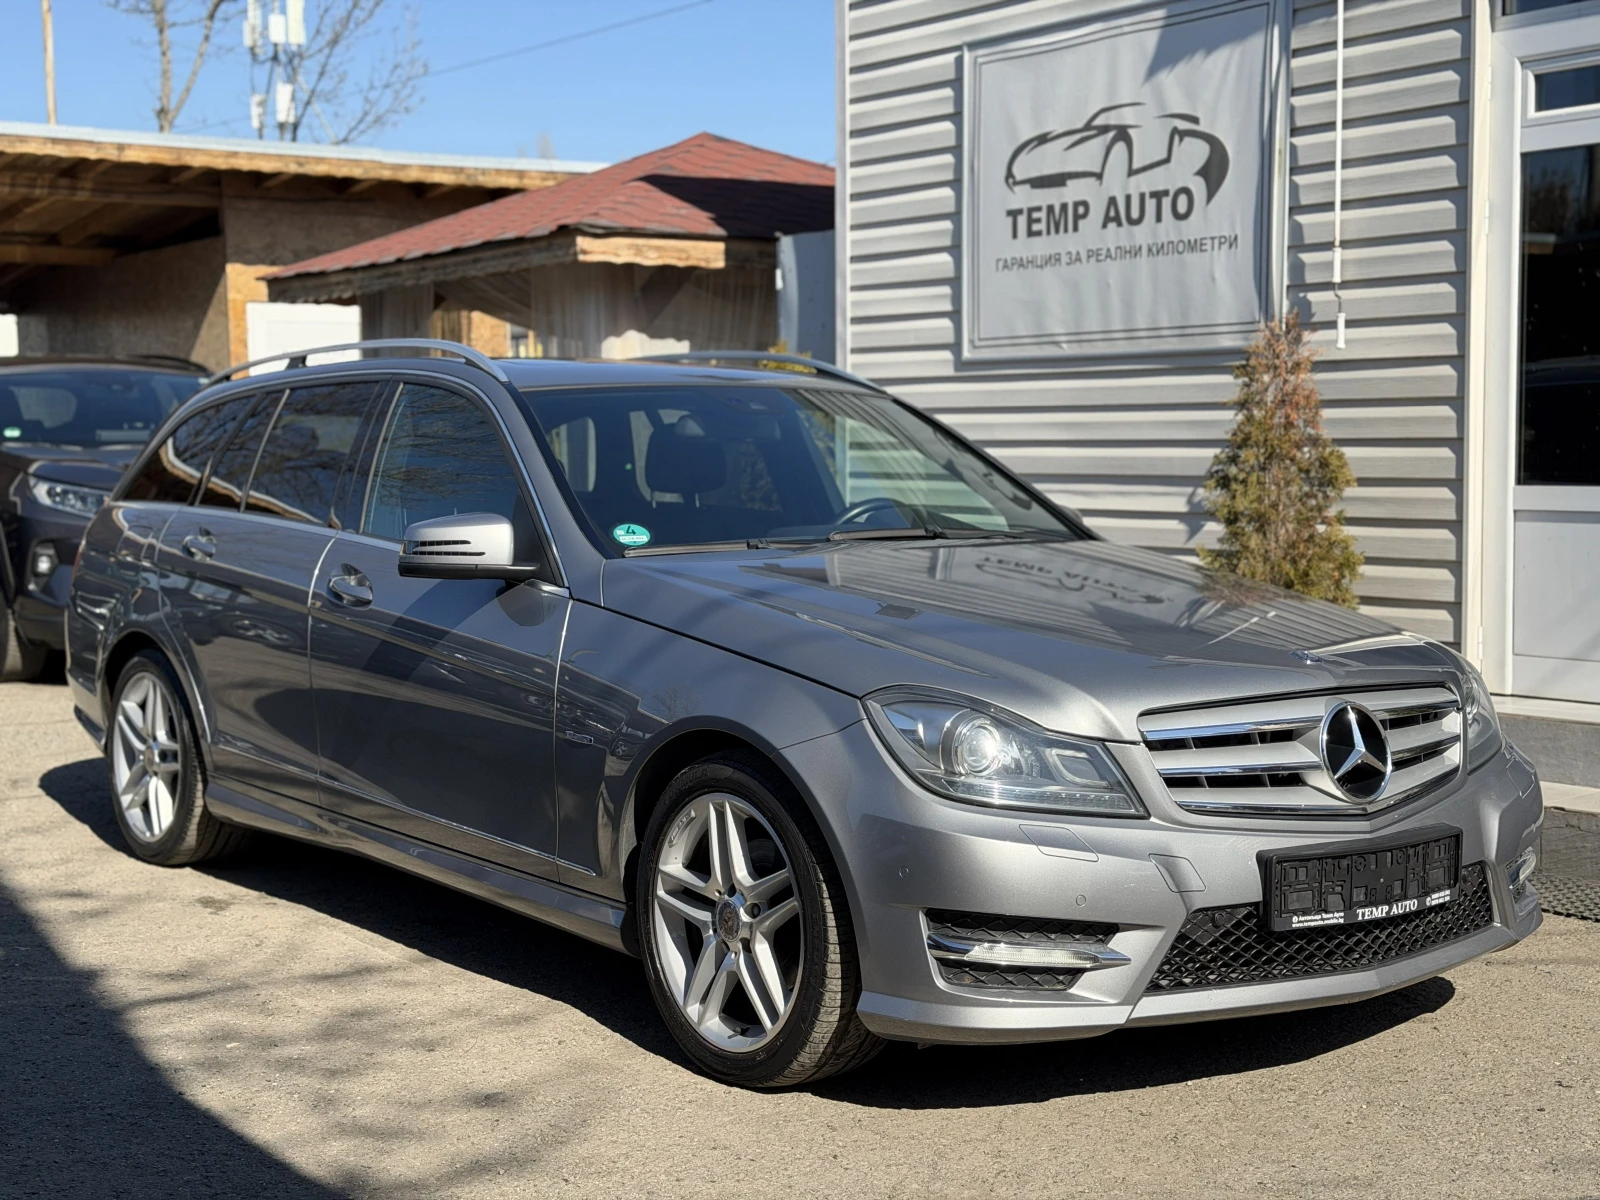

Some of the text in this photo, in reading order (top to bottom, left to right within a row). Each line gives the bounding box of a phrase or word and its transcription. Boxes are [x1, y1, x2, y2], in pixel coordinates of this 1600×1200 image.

[1006, 187, 1195, 240] TEMP AUTO
[995, 234, 1239, 273] ГАРАНЦИЯ ЗА РЕАЛНИ КИЛОМЕТРИ
[625, 525, 637, 535] 4
[1356, 905, 1389, 921] TEMP
[1390, 899, 1418, 916] AUTO
